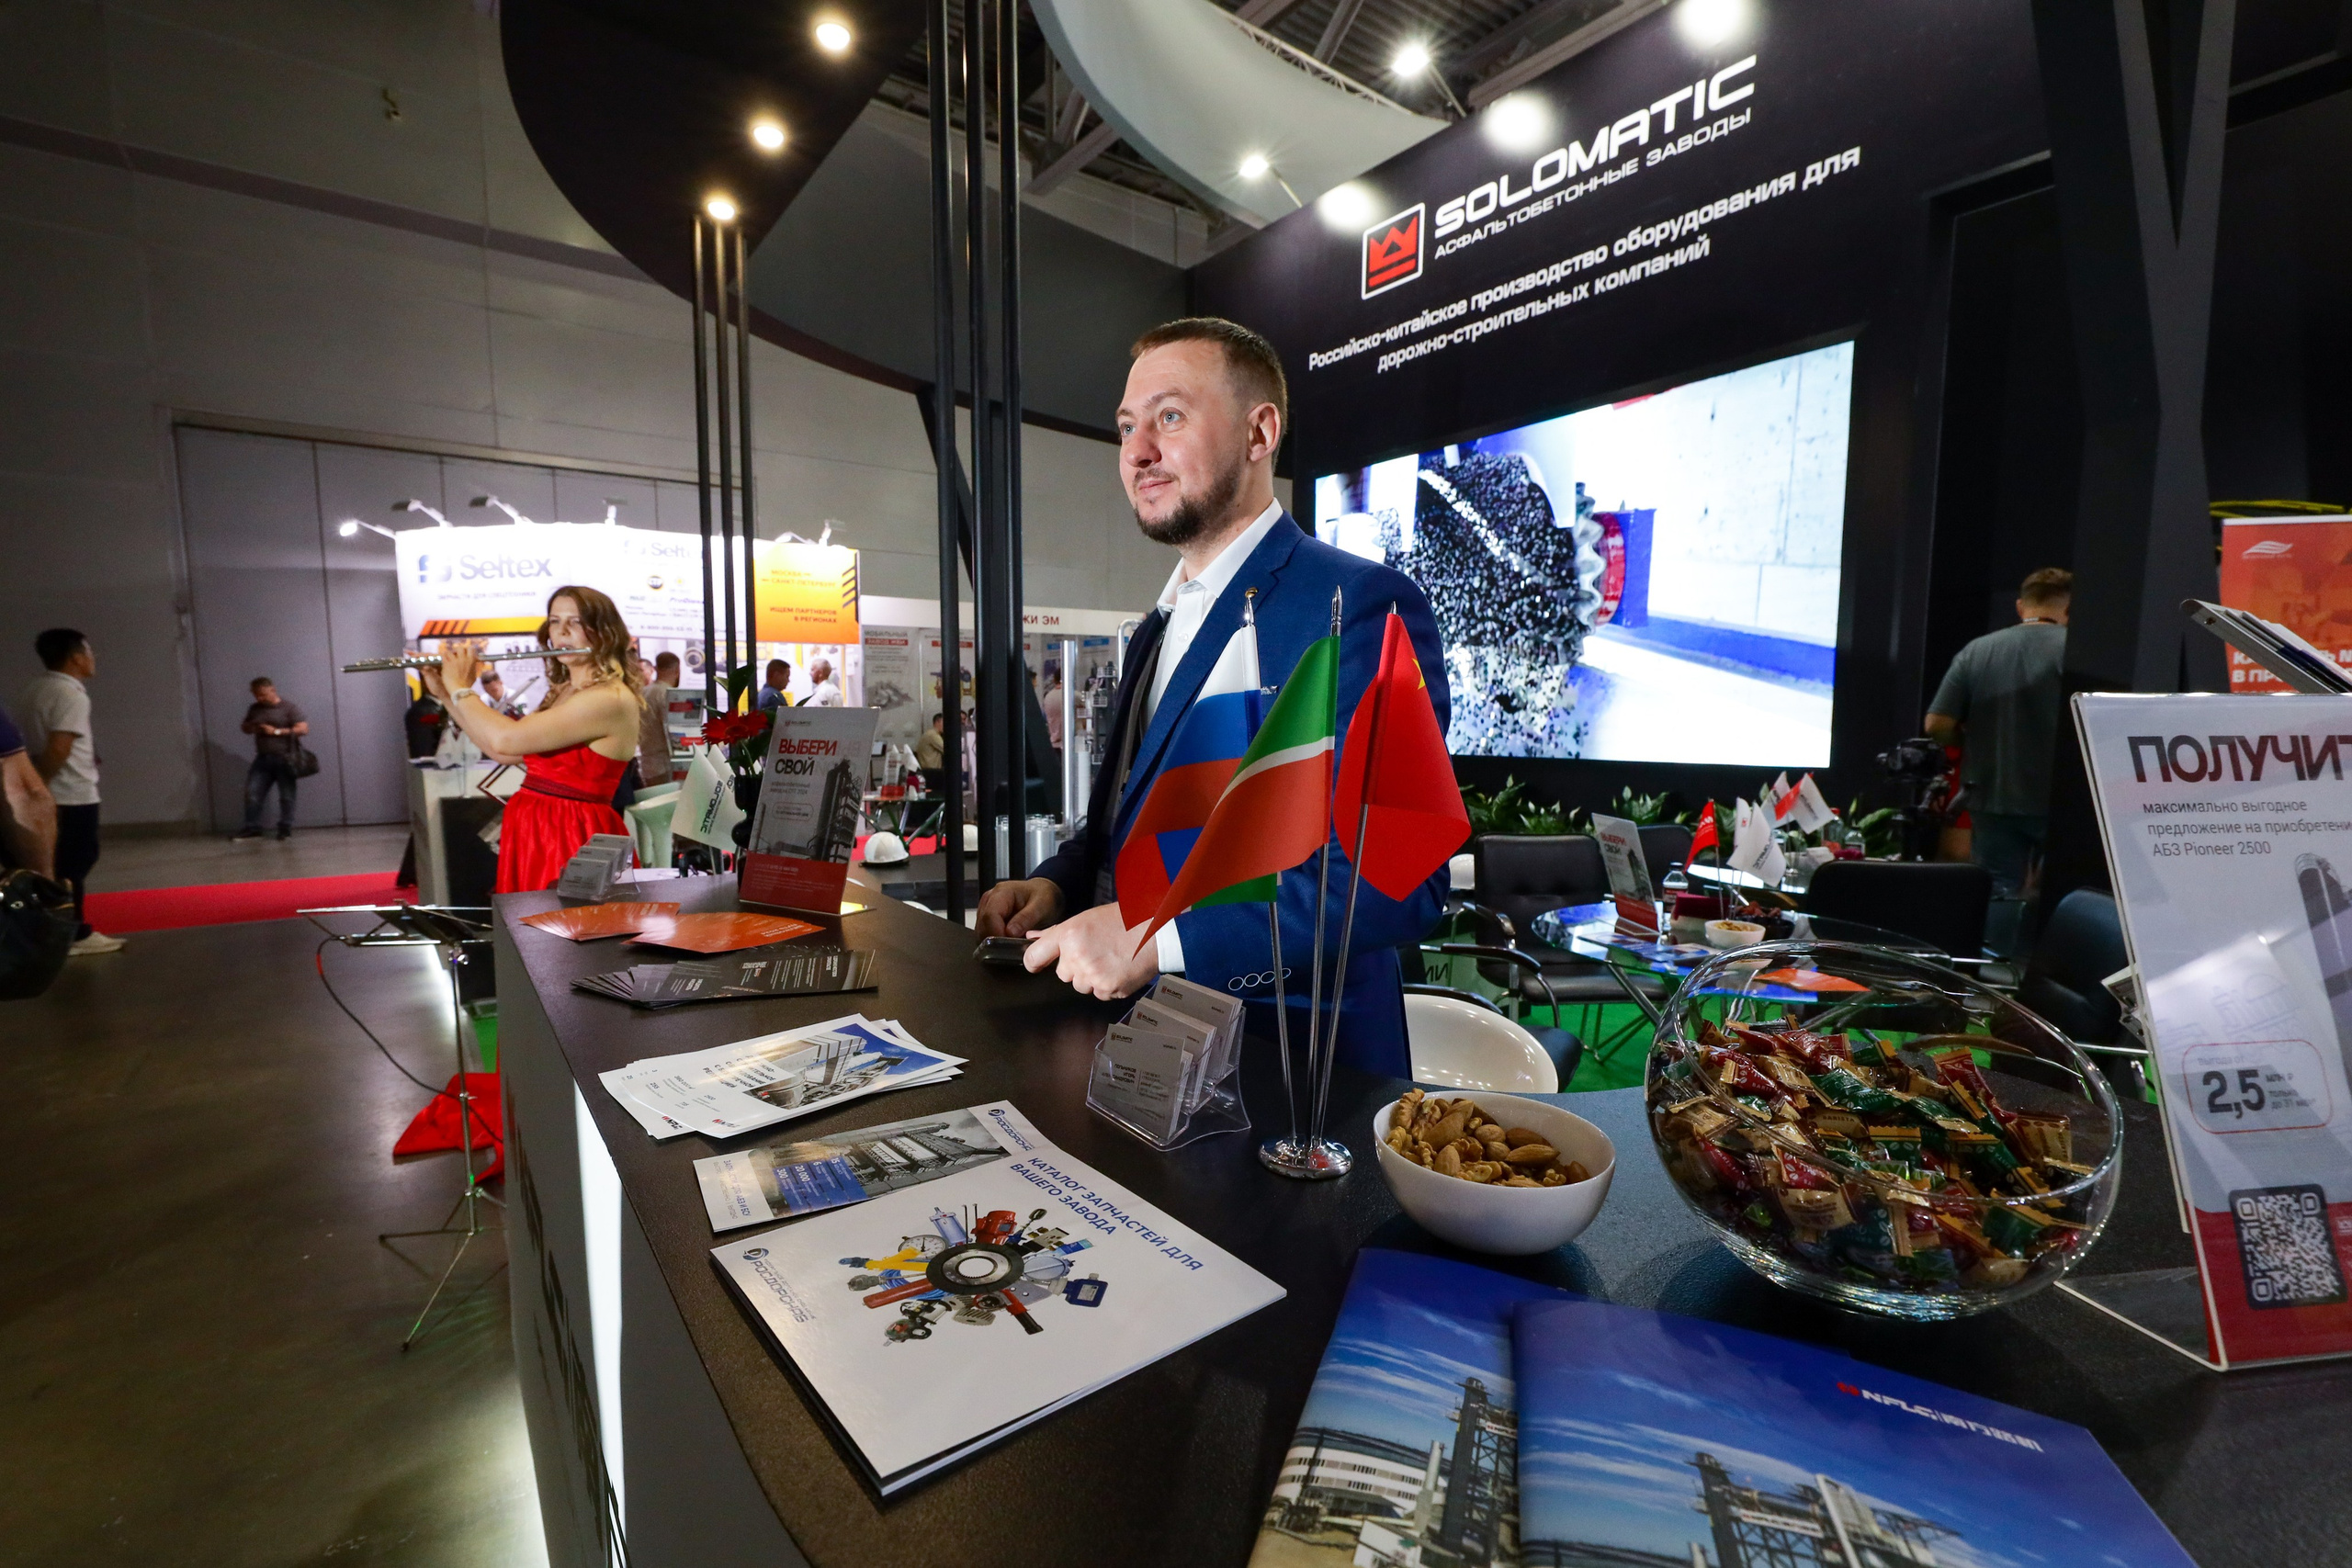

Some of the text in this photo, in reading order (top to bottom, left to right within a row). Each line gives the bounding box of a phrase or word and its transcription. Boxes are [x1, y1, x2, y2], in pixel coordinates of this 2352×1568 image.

[1435, 54, 1757, 238] SOLOMATIC
[1434, 107, 1751, 260] АСФАЛЬТОБЕТОННЫЕ ЗАВОДЫ
[1308, 147, 1860, 370] Российско-китайское производство оборудования для
[1377, 235, 1710, 373] дорожно-строительных компаний
[459, 553, 553, 580] Seltex
[1042, 615, 1059, 626] ЭМ
[2232, 670, 2245, 682] В
[775, 756, 816, 775] СВОЙ
[778, 739, 838, 756] ВЫБЕРИ
[2143, 799, 2307, 816] максимально выгодное
[2148, 820, 2242, 838] предложение
[2245, 821, 2261, 834] на
[2153, 840, 2271, 857] АБЗ Pioneer 2500
[2202, 1069, 2266, 1119] 2,5
[1010, 1163, 1117, 1235] ВАШЕГО ЗАВОДА
[1027, 1157, 1204, 1271] КАТАЛОГ ЗАПЧАСТЕЙ ДЛЯ
[751, 1260, 808, 1323] РОСДОРСНАБ
